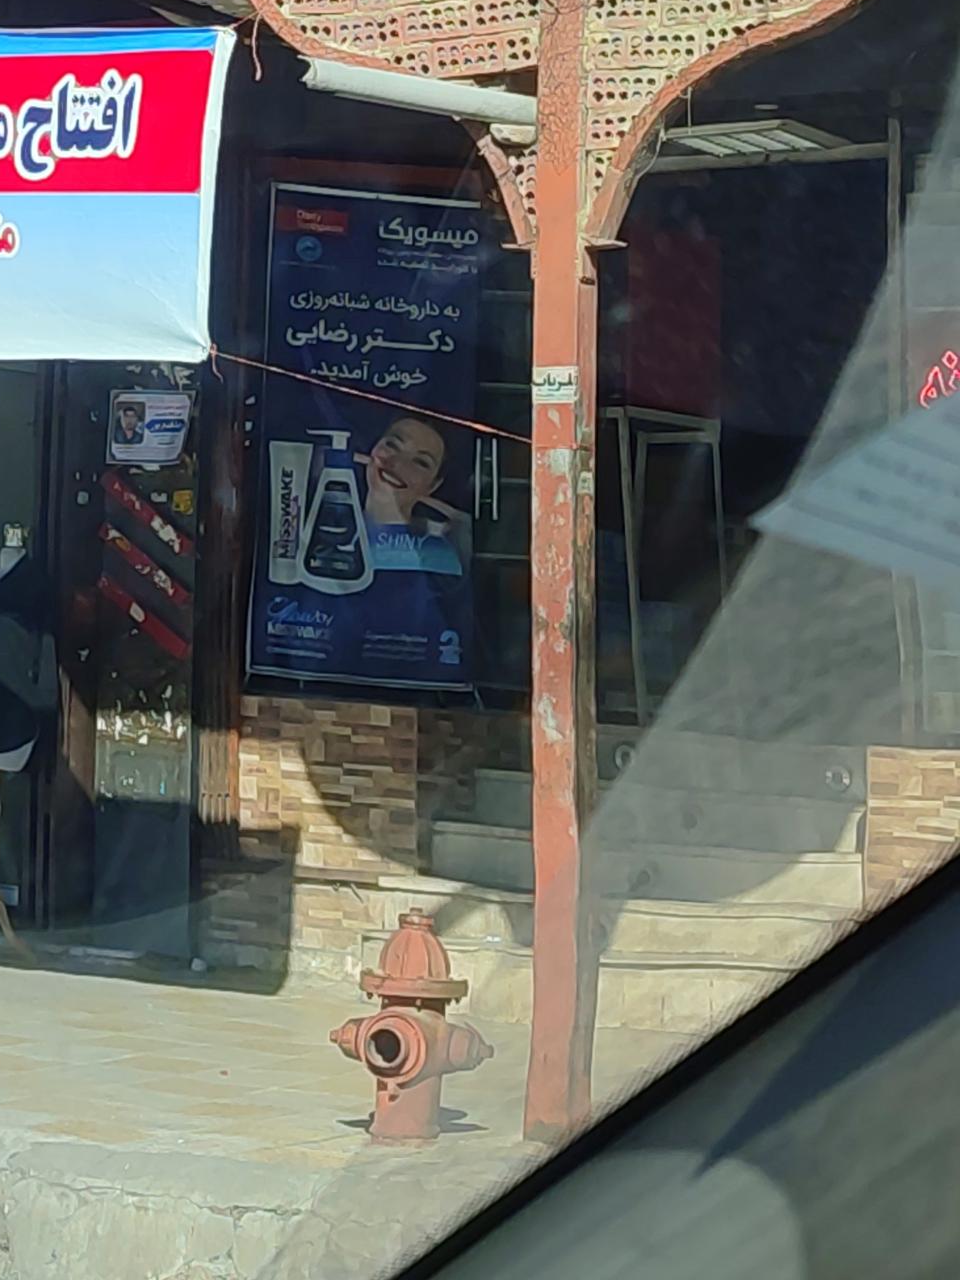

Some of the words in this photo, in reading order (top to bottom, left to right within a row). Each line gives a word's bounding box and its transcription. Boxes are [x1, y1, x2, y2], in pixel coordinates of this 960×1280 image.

[18, 74, 138, 176] افتتاح
[379, 218, 478, 248] میسویک
[375, 296, 440, 321] داروخانه
[444, 304, 460, 322] به
[286, 320, 358, 352] رضایی
[361, 329, 454, 354] دکتر
[373, 366, 428, 390] خوش
